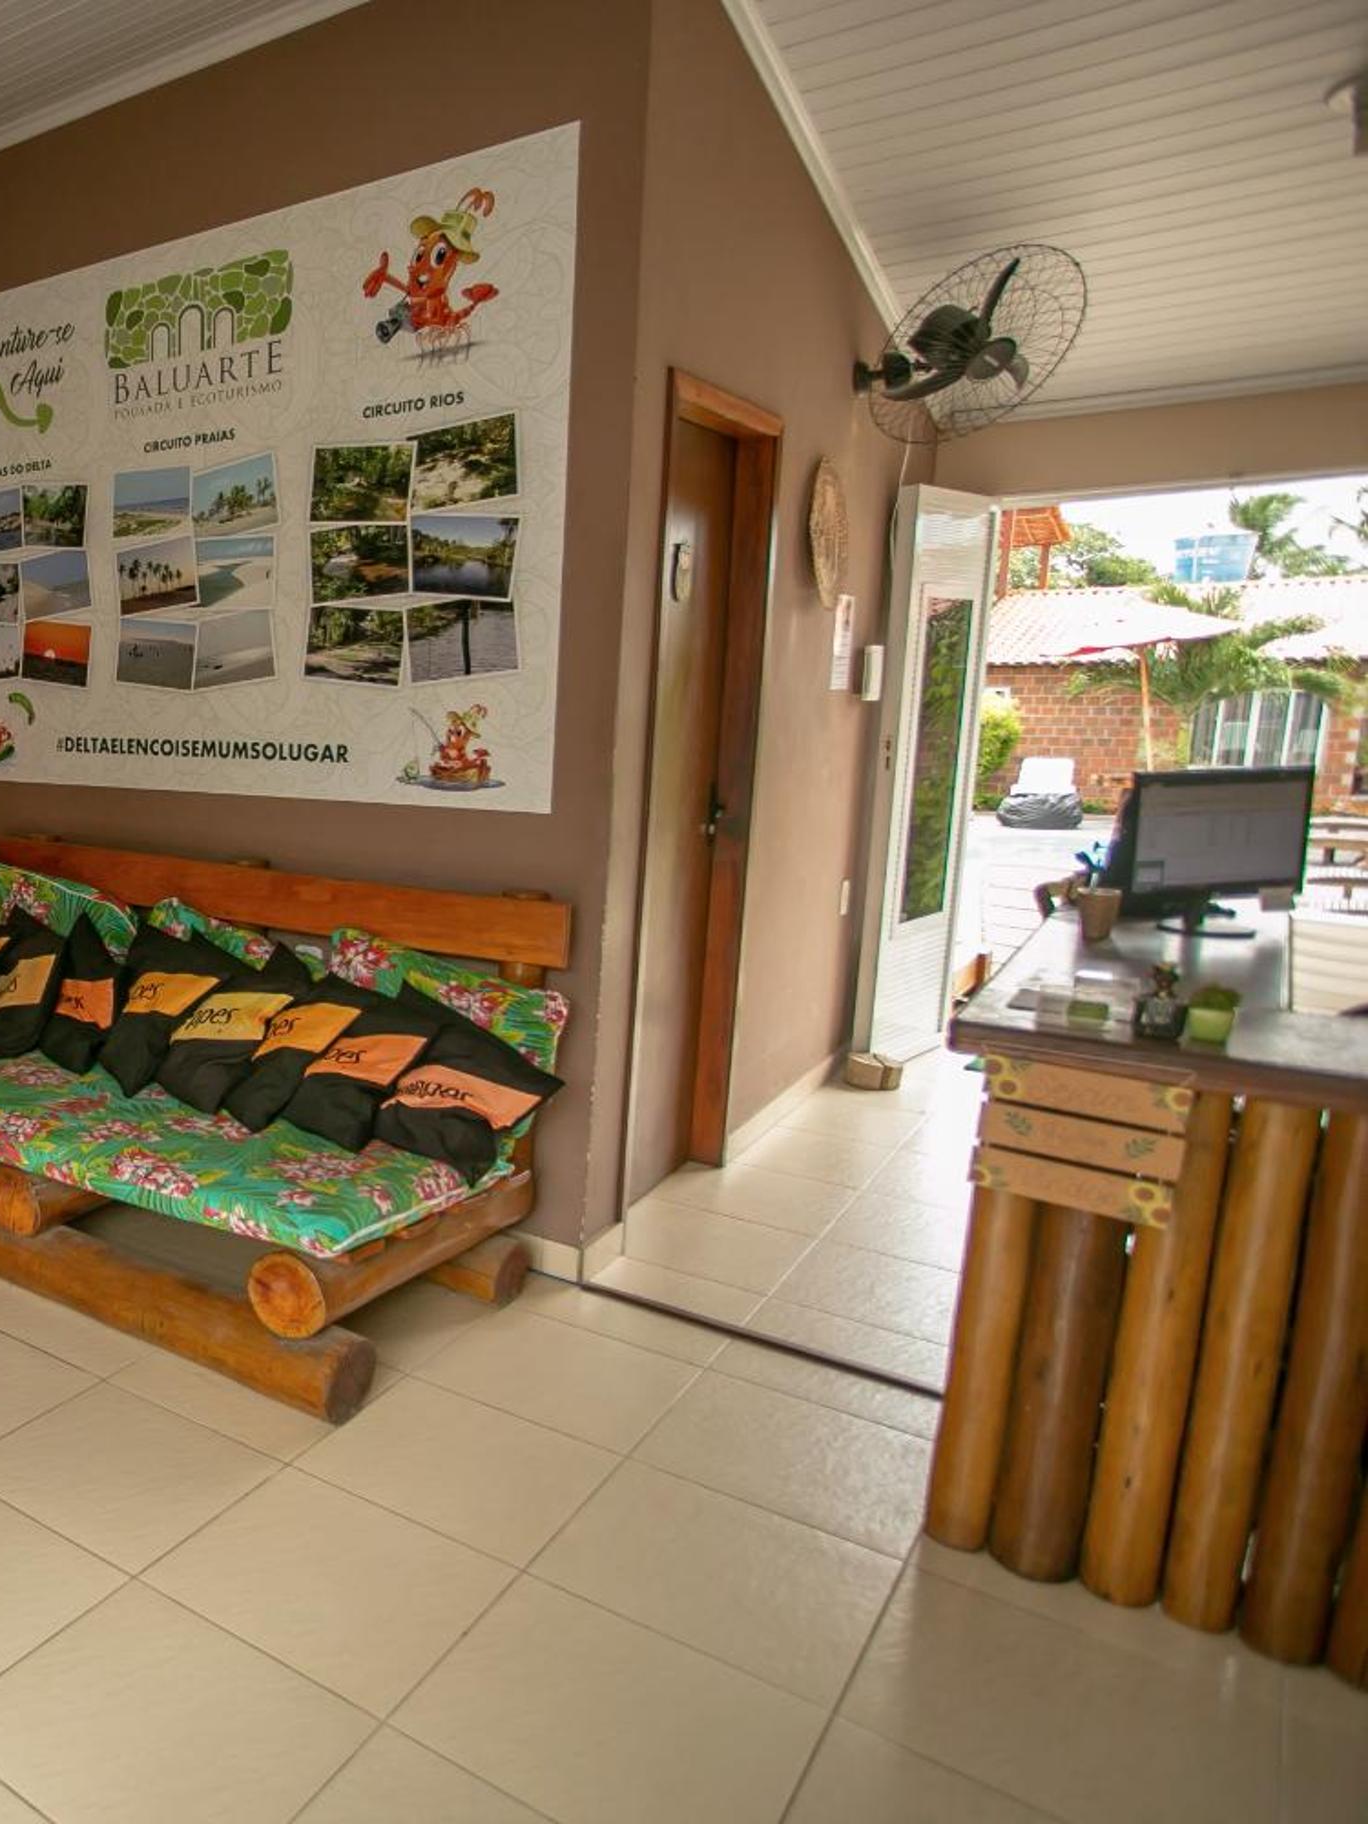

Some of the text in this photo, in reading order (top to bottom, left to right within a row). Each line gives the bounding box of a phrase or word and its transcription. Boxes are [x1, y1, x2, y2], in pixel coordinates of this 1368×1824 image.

[10, 357, 65, 399] Aqui
[114, 339, 284, 405] BALUARTE
[189, 379, 283, 409] ECOTURISMO
[362, 391, 465, 420] CIRCUITO RIOS
[143, 428, 237, 454] CIRCUITO PRAIAS
[25, 459, 53, 476] DELTA
[55, 736, 350, 764] #DELTAELENCOISEMUMSOLUGAR
